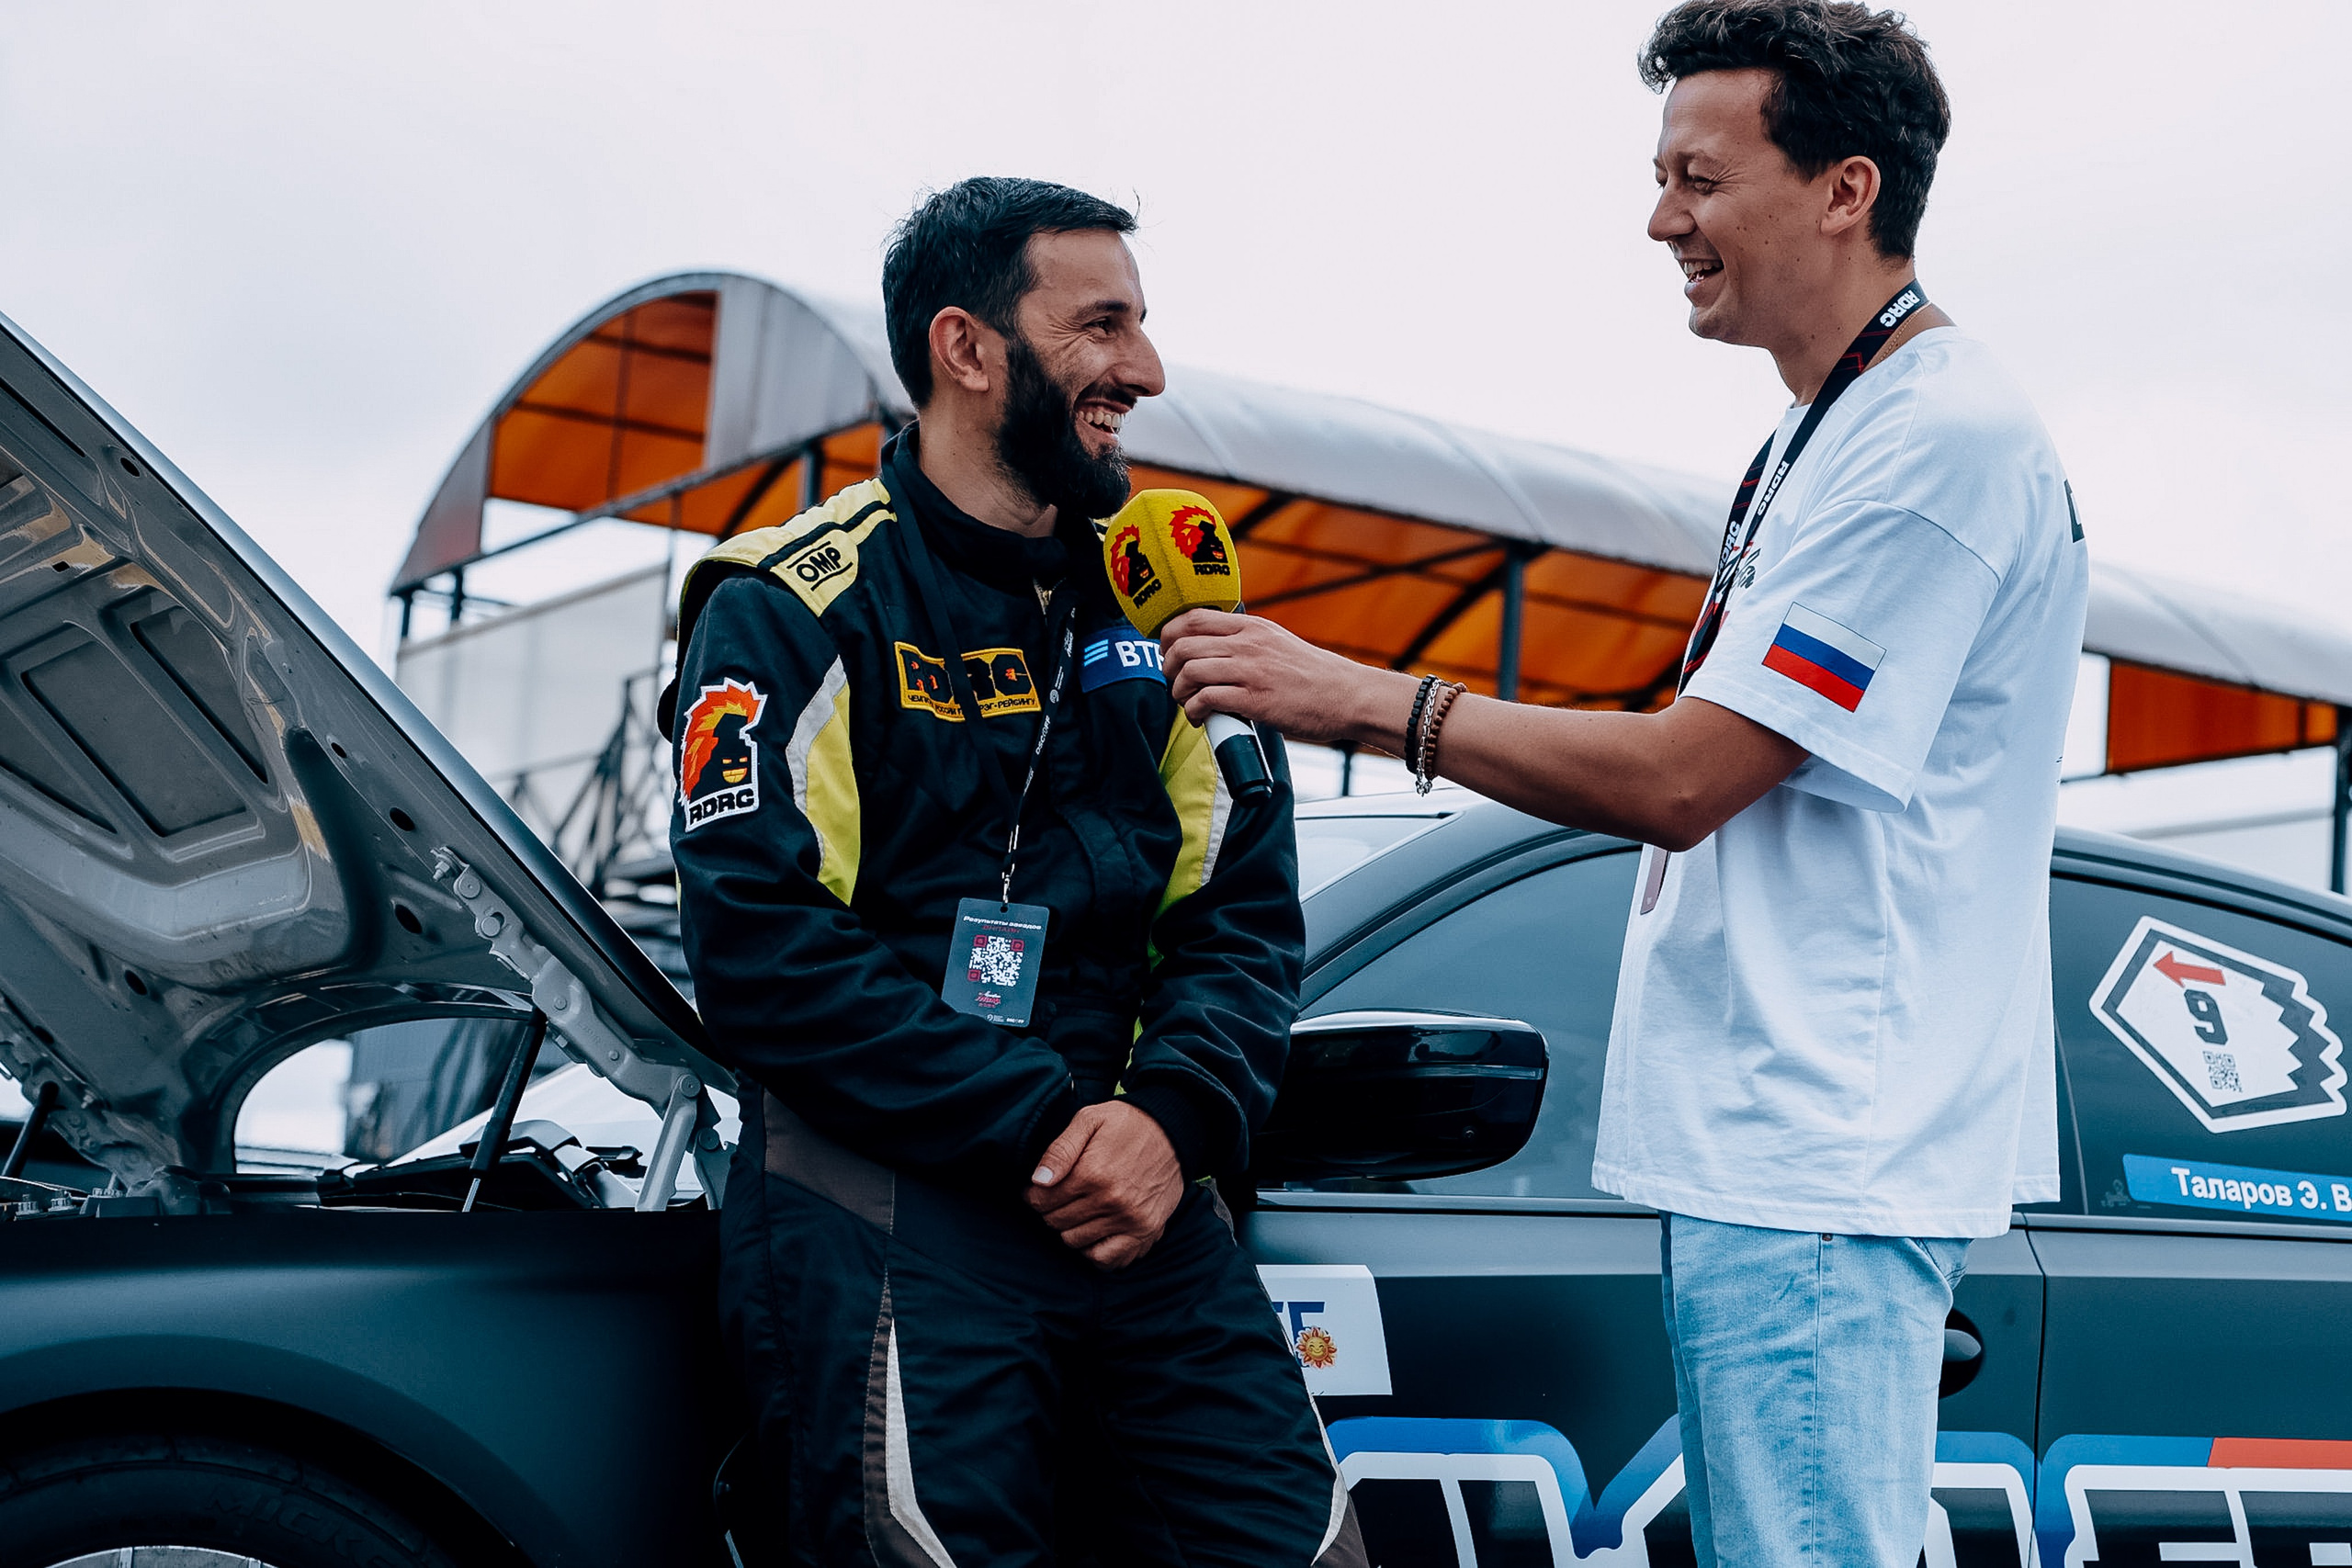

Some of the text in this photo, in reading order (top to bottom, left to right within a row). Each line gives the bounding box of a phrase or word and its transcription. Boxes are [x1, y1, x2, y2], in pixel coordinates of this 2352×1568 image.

[1880, 289, 1921, 328] RDRC
[796, 547, 842, 582] OMP
[1193, 563, 1231, 576] RDRC
[1132, 578, 1162, 609] RDRC
[689, 787, 755, 826] RDRC
[2184, 988, 2229, 1045] 9
[2170, 1167, 2294, 1210] Таларов
[2297, 1179, 2328, 1211] Э.
